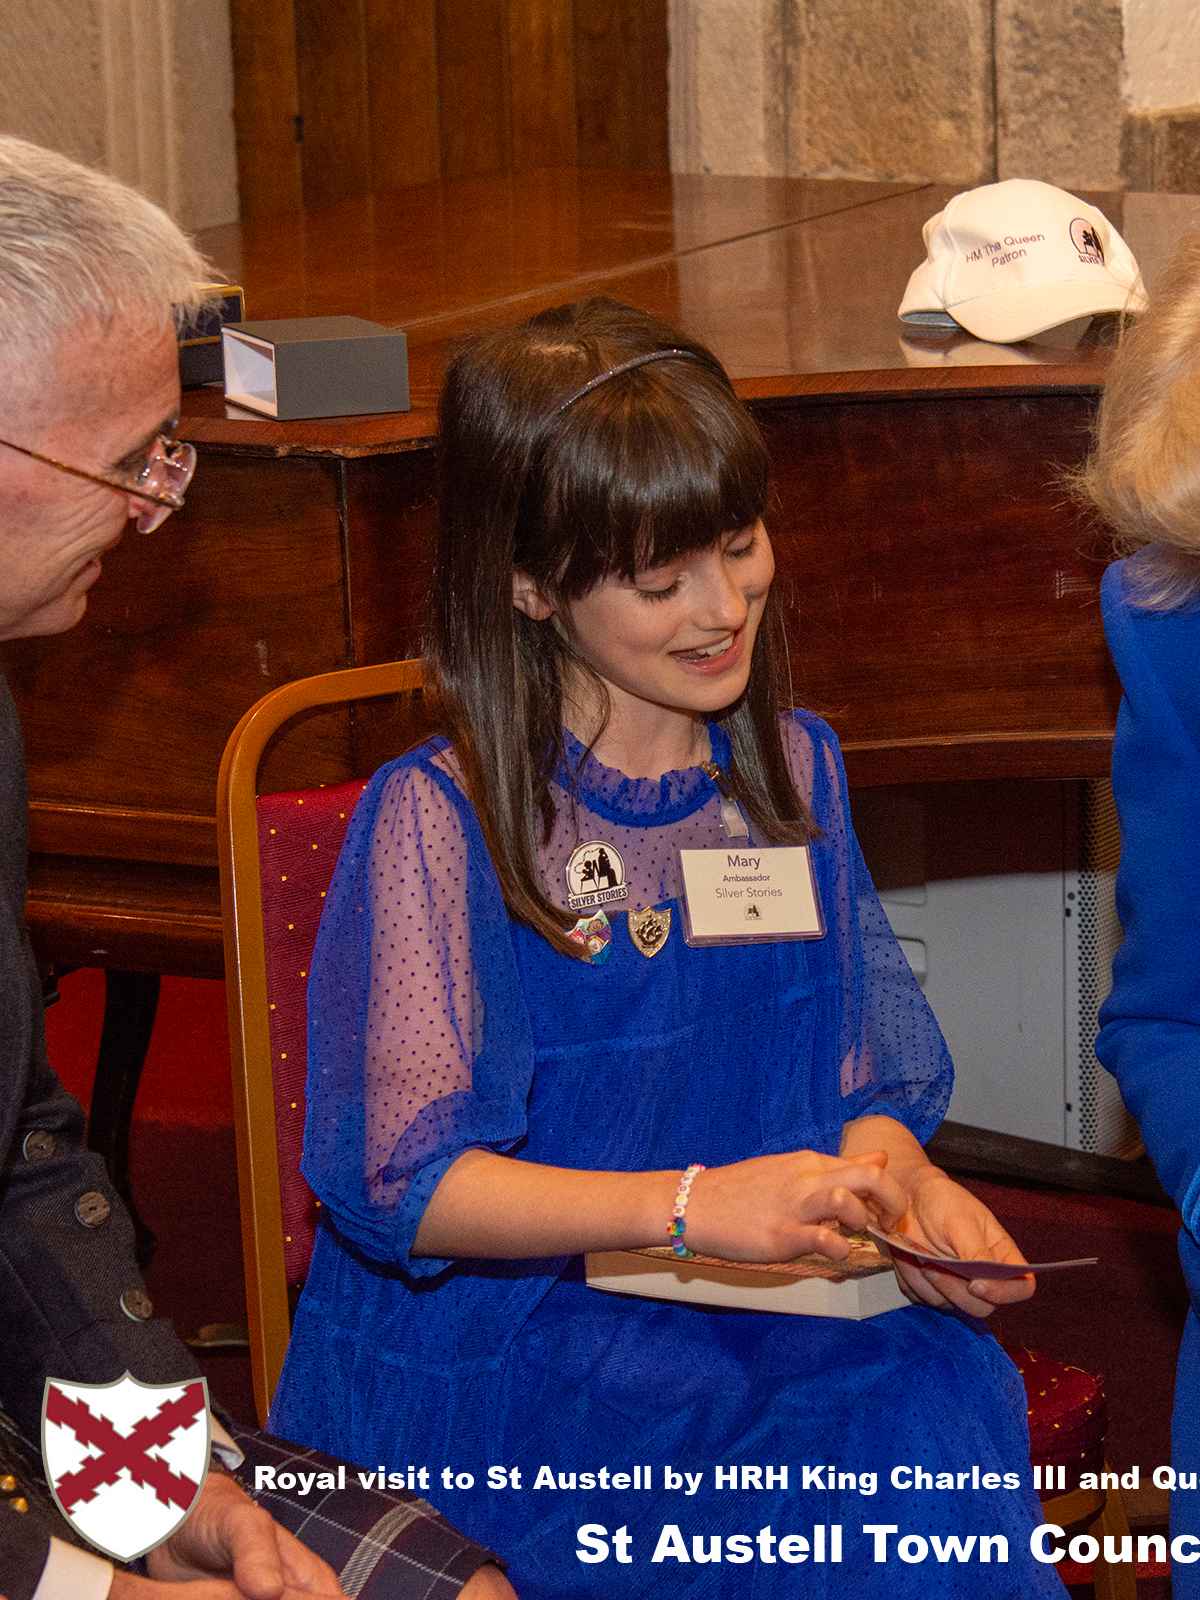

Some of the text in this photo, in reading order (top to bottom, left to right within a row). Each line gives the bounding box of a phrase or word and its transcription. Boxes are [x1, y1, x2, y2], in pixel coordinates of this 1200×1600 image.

[965, 248, 983, 263] HM
[1004, 234, 1045, 246] Queen
[991, 249, 1027, 268] Patron
[727, 855, 761, 870] Mary
[722, 874, 770, 882] Ambassador
[571, 887, 627, 908] SILVER STORIES
[715, 887, 783, 898] Silver Stories
